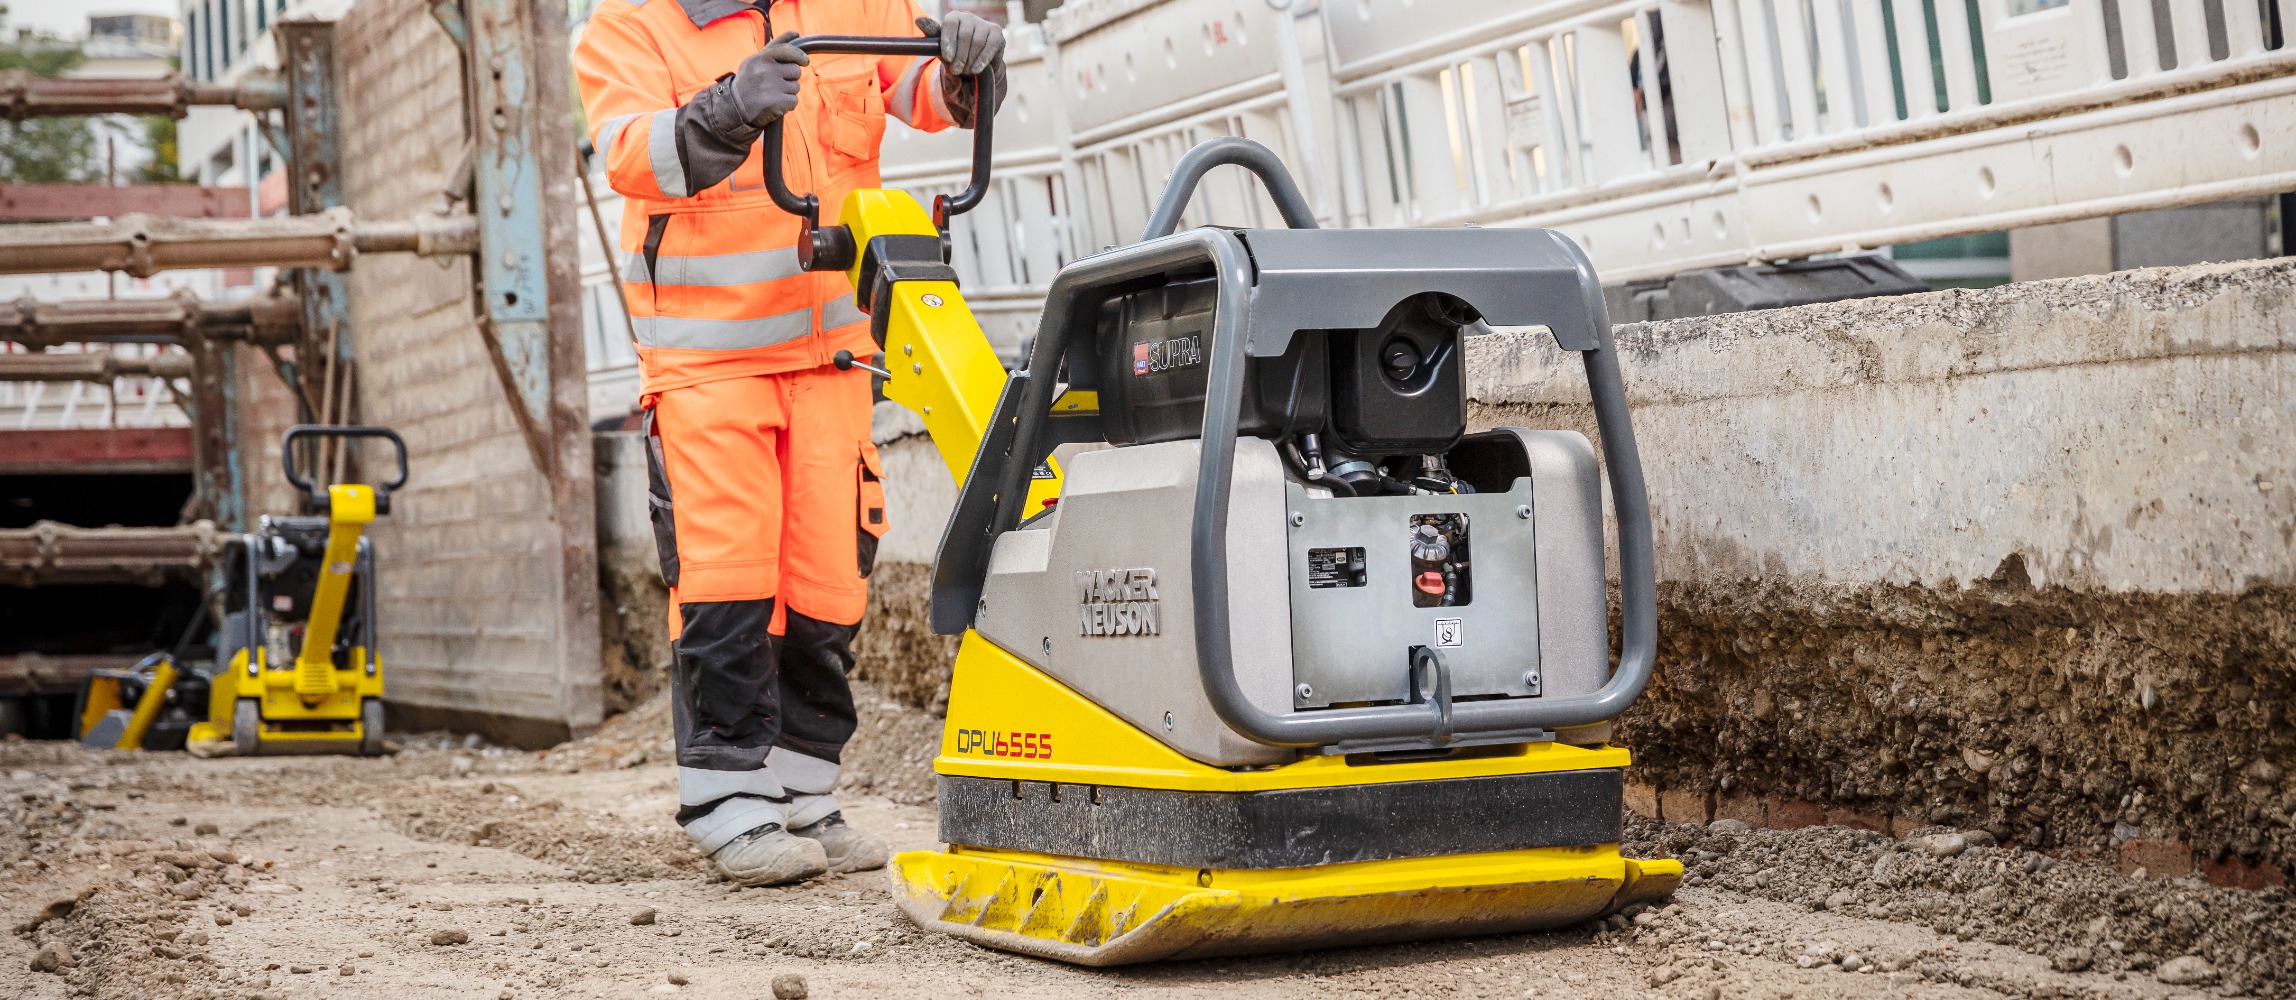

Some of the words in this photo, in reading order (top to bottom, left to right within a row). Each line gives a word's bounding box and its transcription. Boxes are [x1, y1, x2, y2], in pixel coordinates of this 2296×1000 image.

[1149, 336, 1201, 372] SUPRA
[1076, 567, 1159, 602] WACKER
[1079, 601, 1161, 636] NEUSON
[957, 728, 1053, 760] DPU6555
